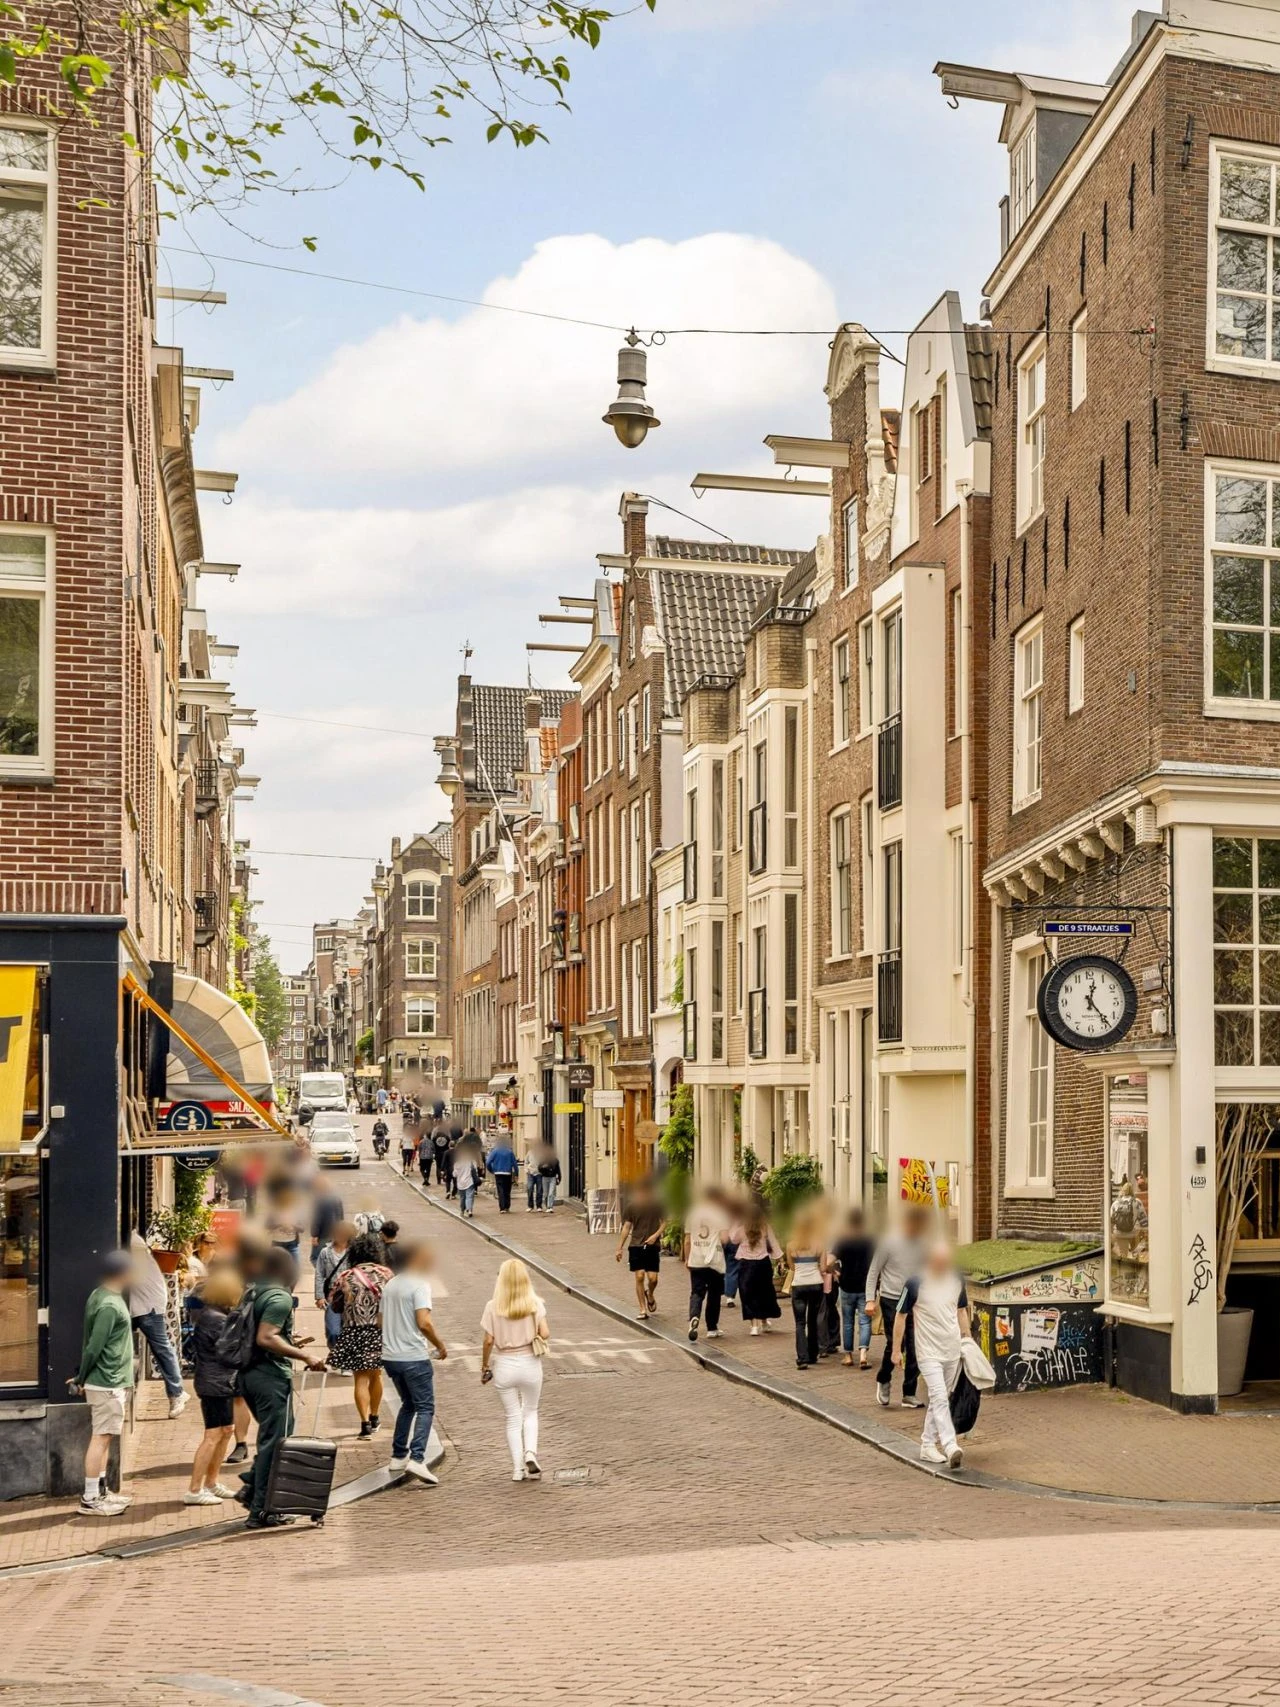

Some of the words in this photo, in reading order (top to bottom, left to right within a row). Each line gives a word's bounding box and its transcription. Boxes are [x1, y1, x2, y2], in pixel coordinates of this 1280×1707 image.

[1058, 924, 1069, 932] DE
[1070, 924, 1076, 932] 9
[1077, 924, 1120, 932] STRAATJES
[1075, 974, 1081, 984] 11
[1086, 971, 1094, 980] 12
[1064, 985, 1072, 994] 10
[1109, 984, 1116, 994] 2
[1087, 1024, 1094, 1033] 6
